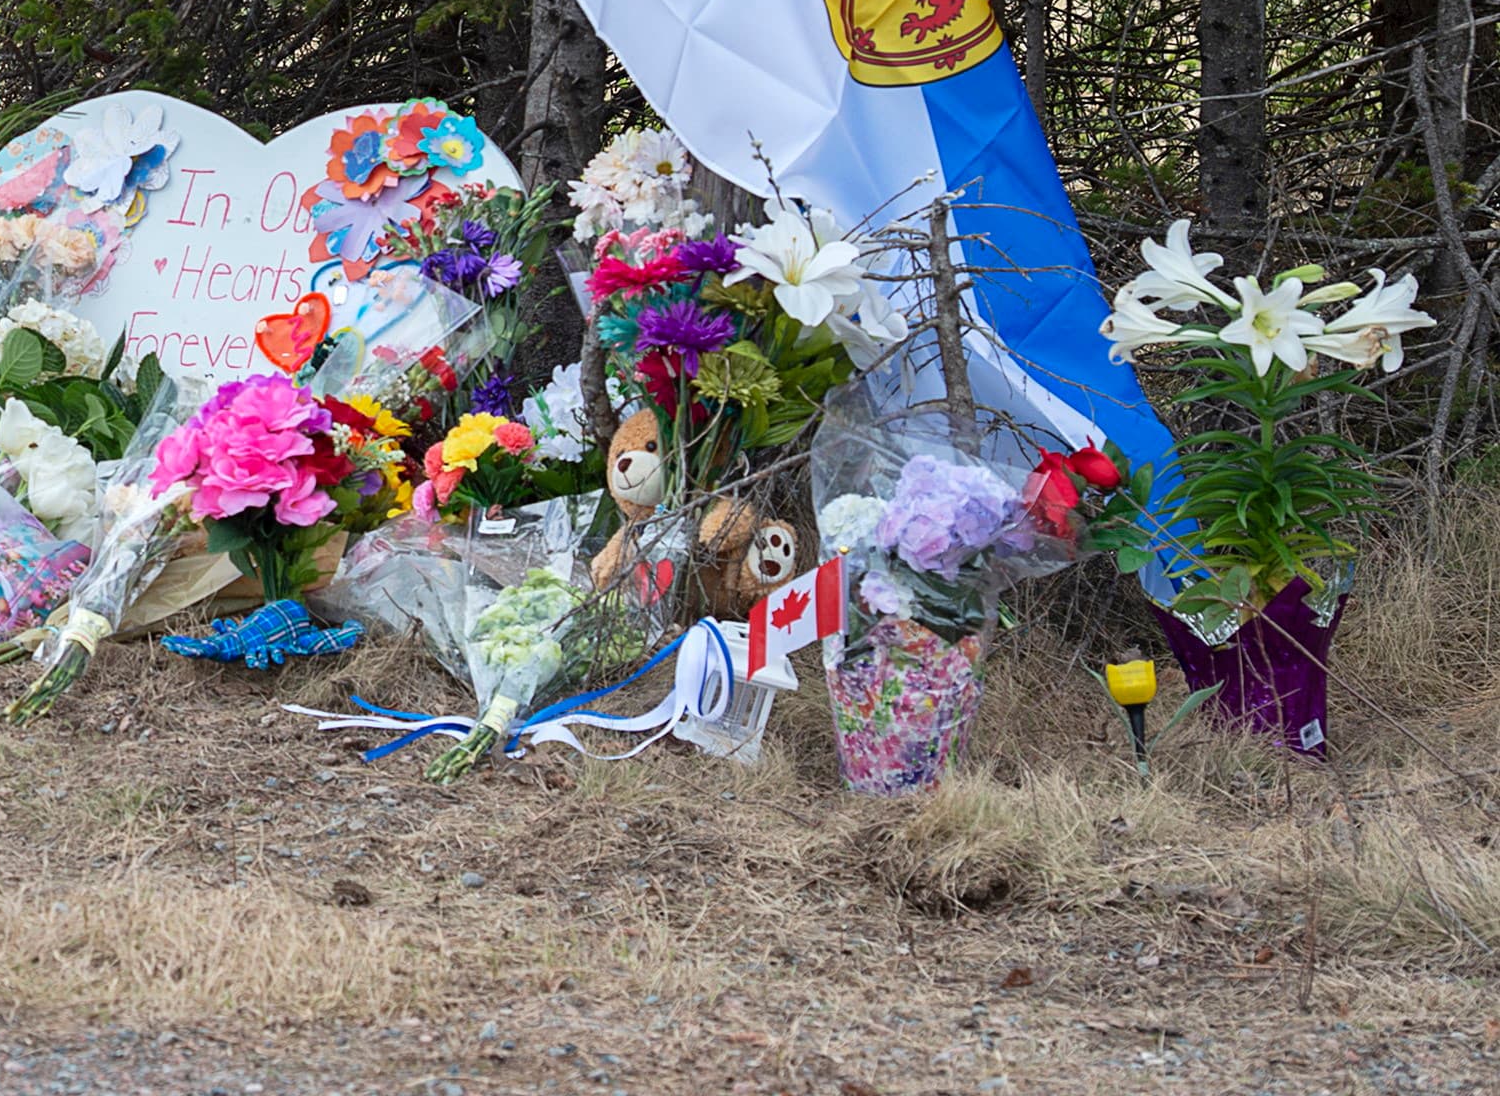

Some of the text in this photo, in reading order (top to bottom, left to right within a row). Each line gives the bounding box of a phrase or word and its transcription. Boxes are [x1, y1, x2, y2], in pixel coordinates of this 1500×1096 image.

[167, 169, 318, 234] In Ou
[172, 245, 305, 303] Hearts
